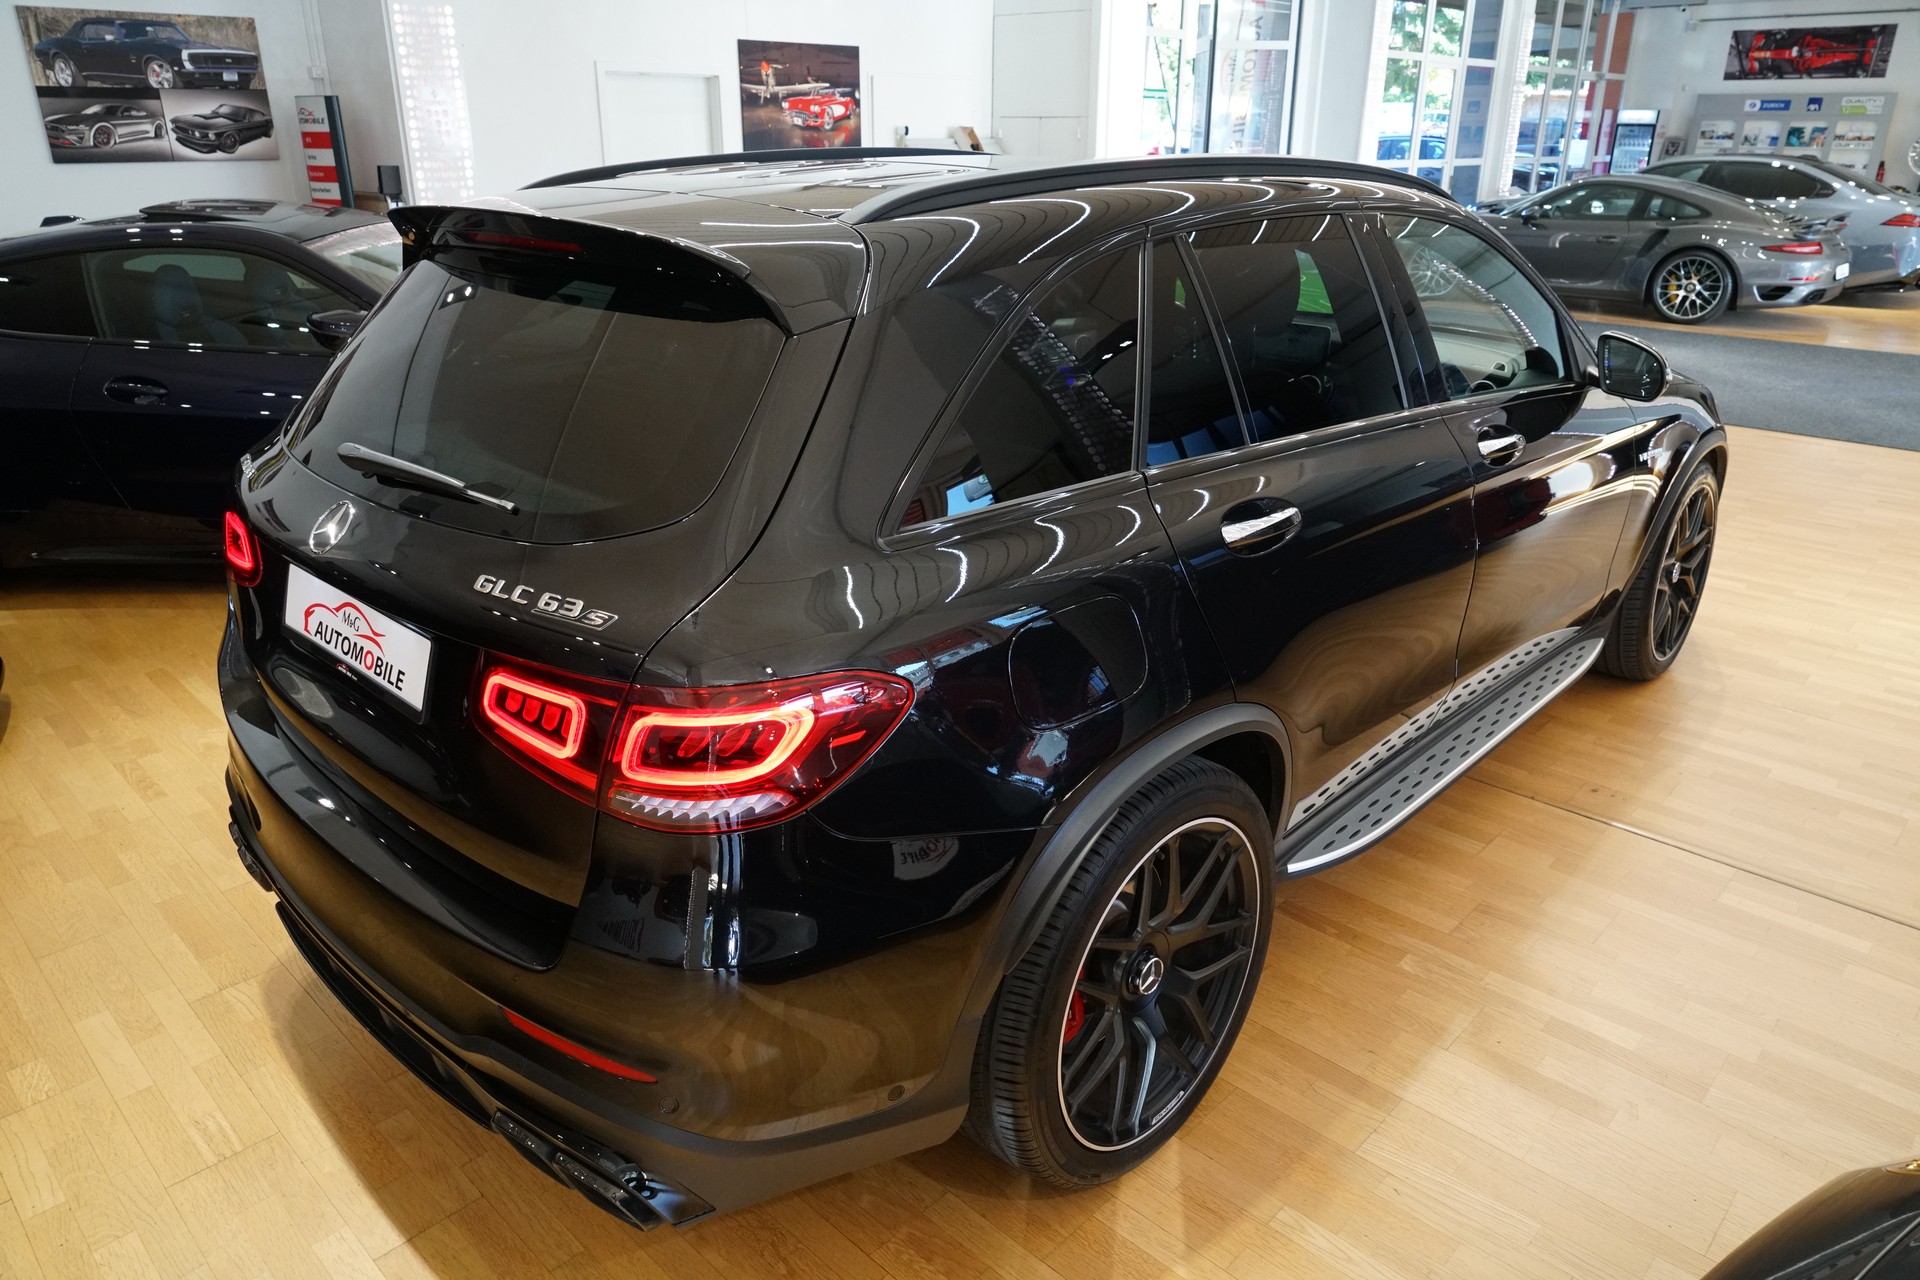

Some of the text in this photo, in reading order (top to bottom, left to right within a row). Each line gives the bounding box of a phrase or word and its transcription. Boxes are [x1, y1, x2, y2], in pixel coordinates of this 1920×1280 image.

[473, 574, 609, 625] GLC 63 S
[314, 621, 405, 691] AUTOMOBILE
